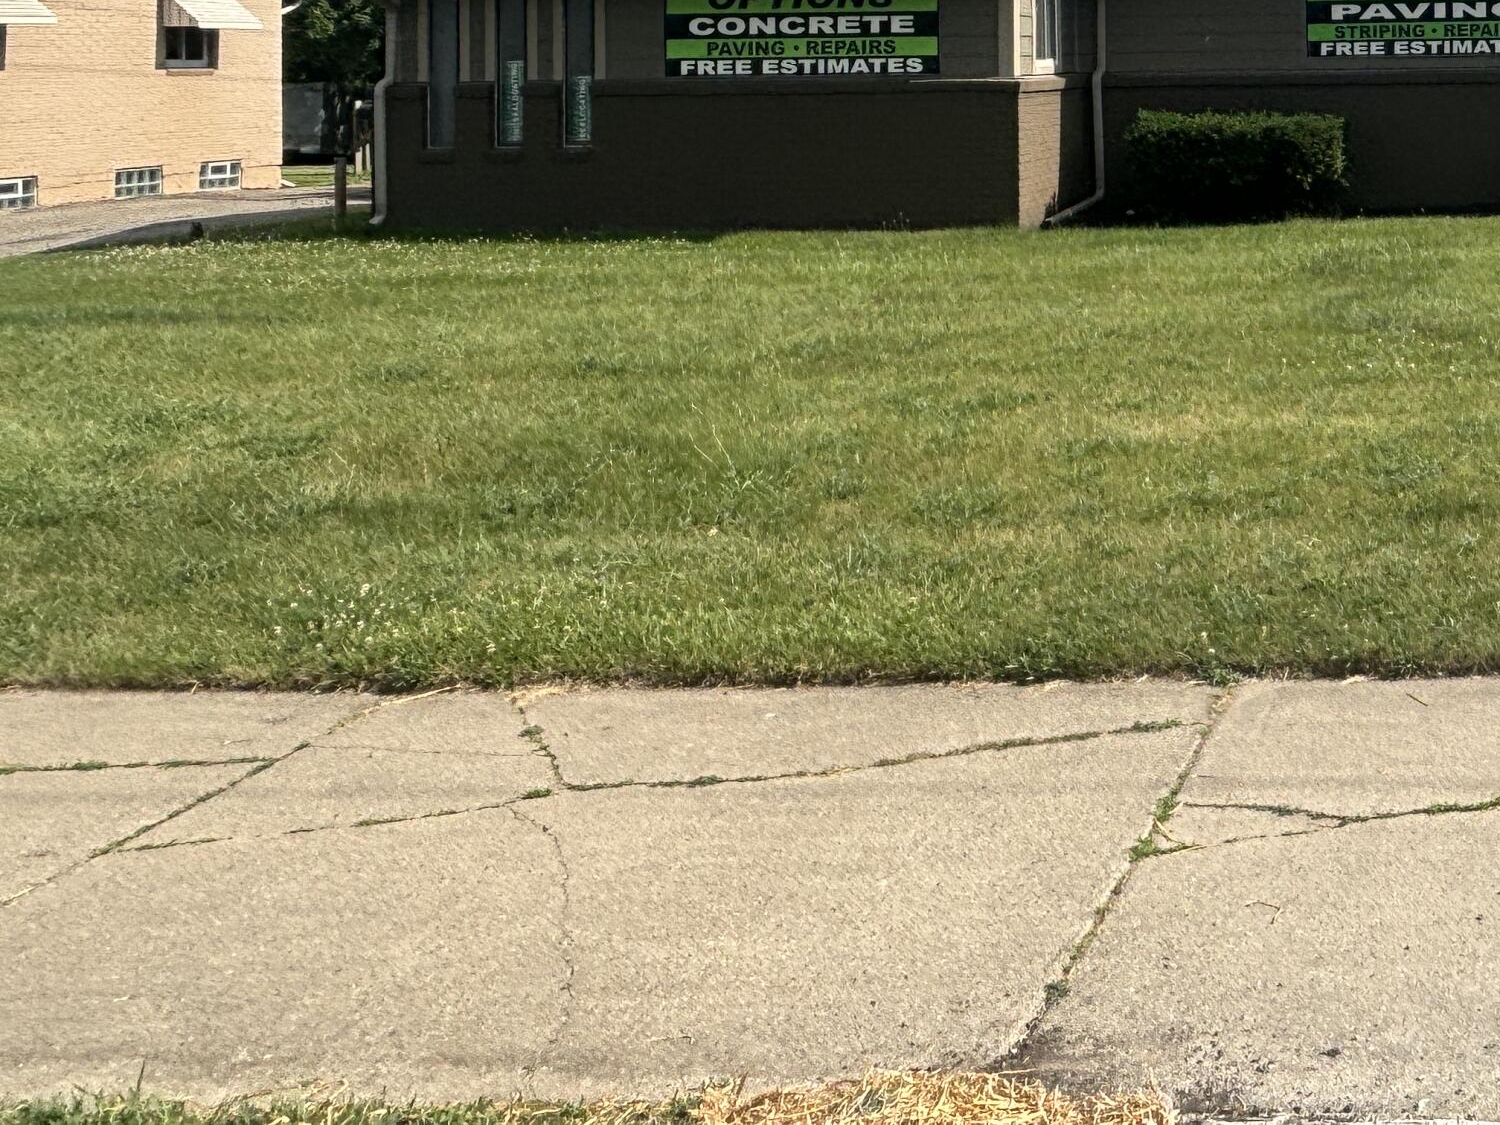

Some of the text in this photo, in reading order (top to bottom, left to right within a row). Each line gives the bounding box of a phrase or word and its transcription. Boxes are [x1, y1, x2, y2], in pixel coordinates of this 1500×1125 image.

[688, 15, 915, 36] CONCRETE
[1334, 24, 1425, 39] STRIPING
[706, 39, 896, 56] PAVING REPAIRS
[1320, 41, 1385, 56] FREE
[680, 57, 924, 75] FREE ESTIMATES
